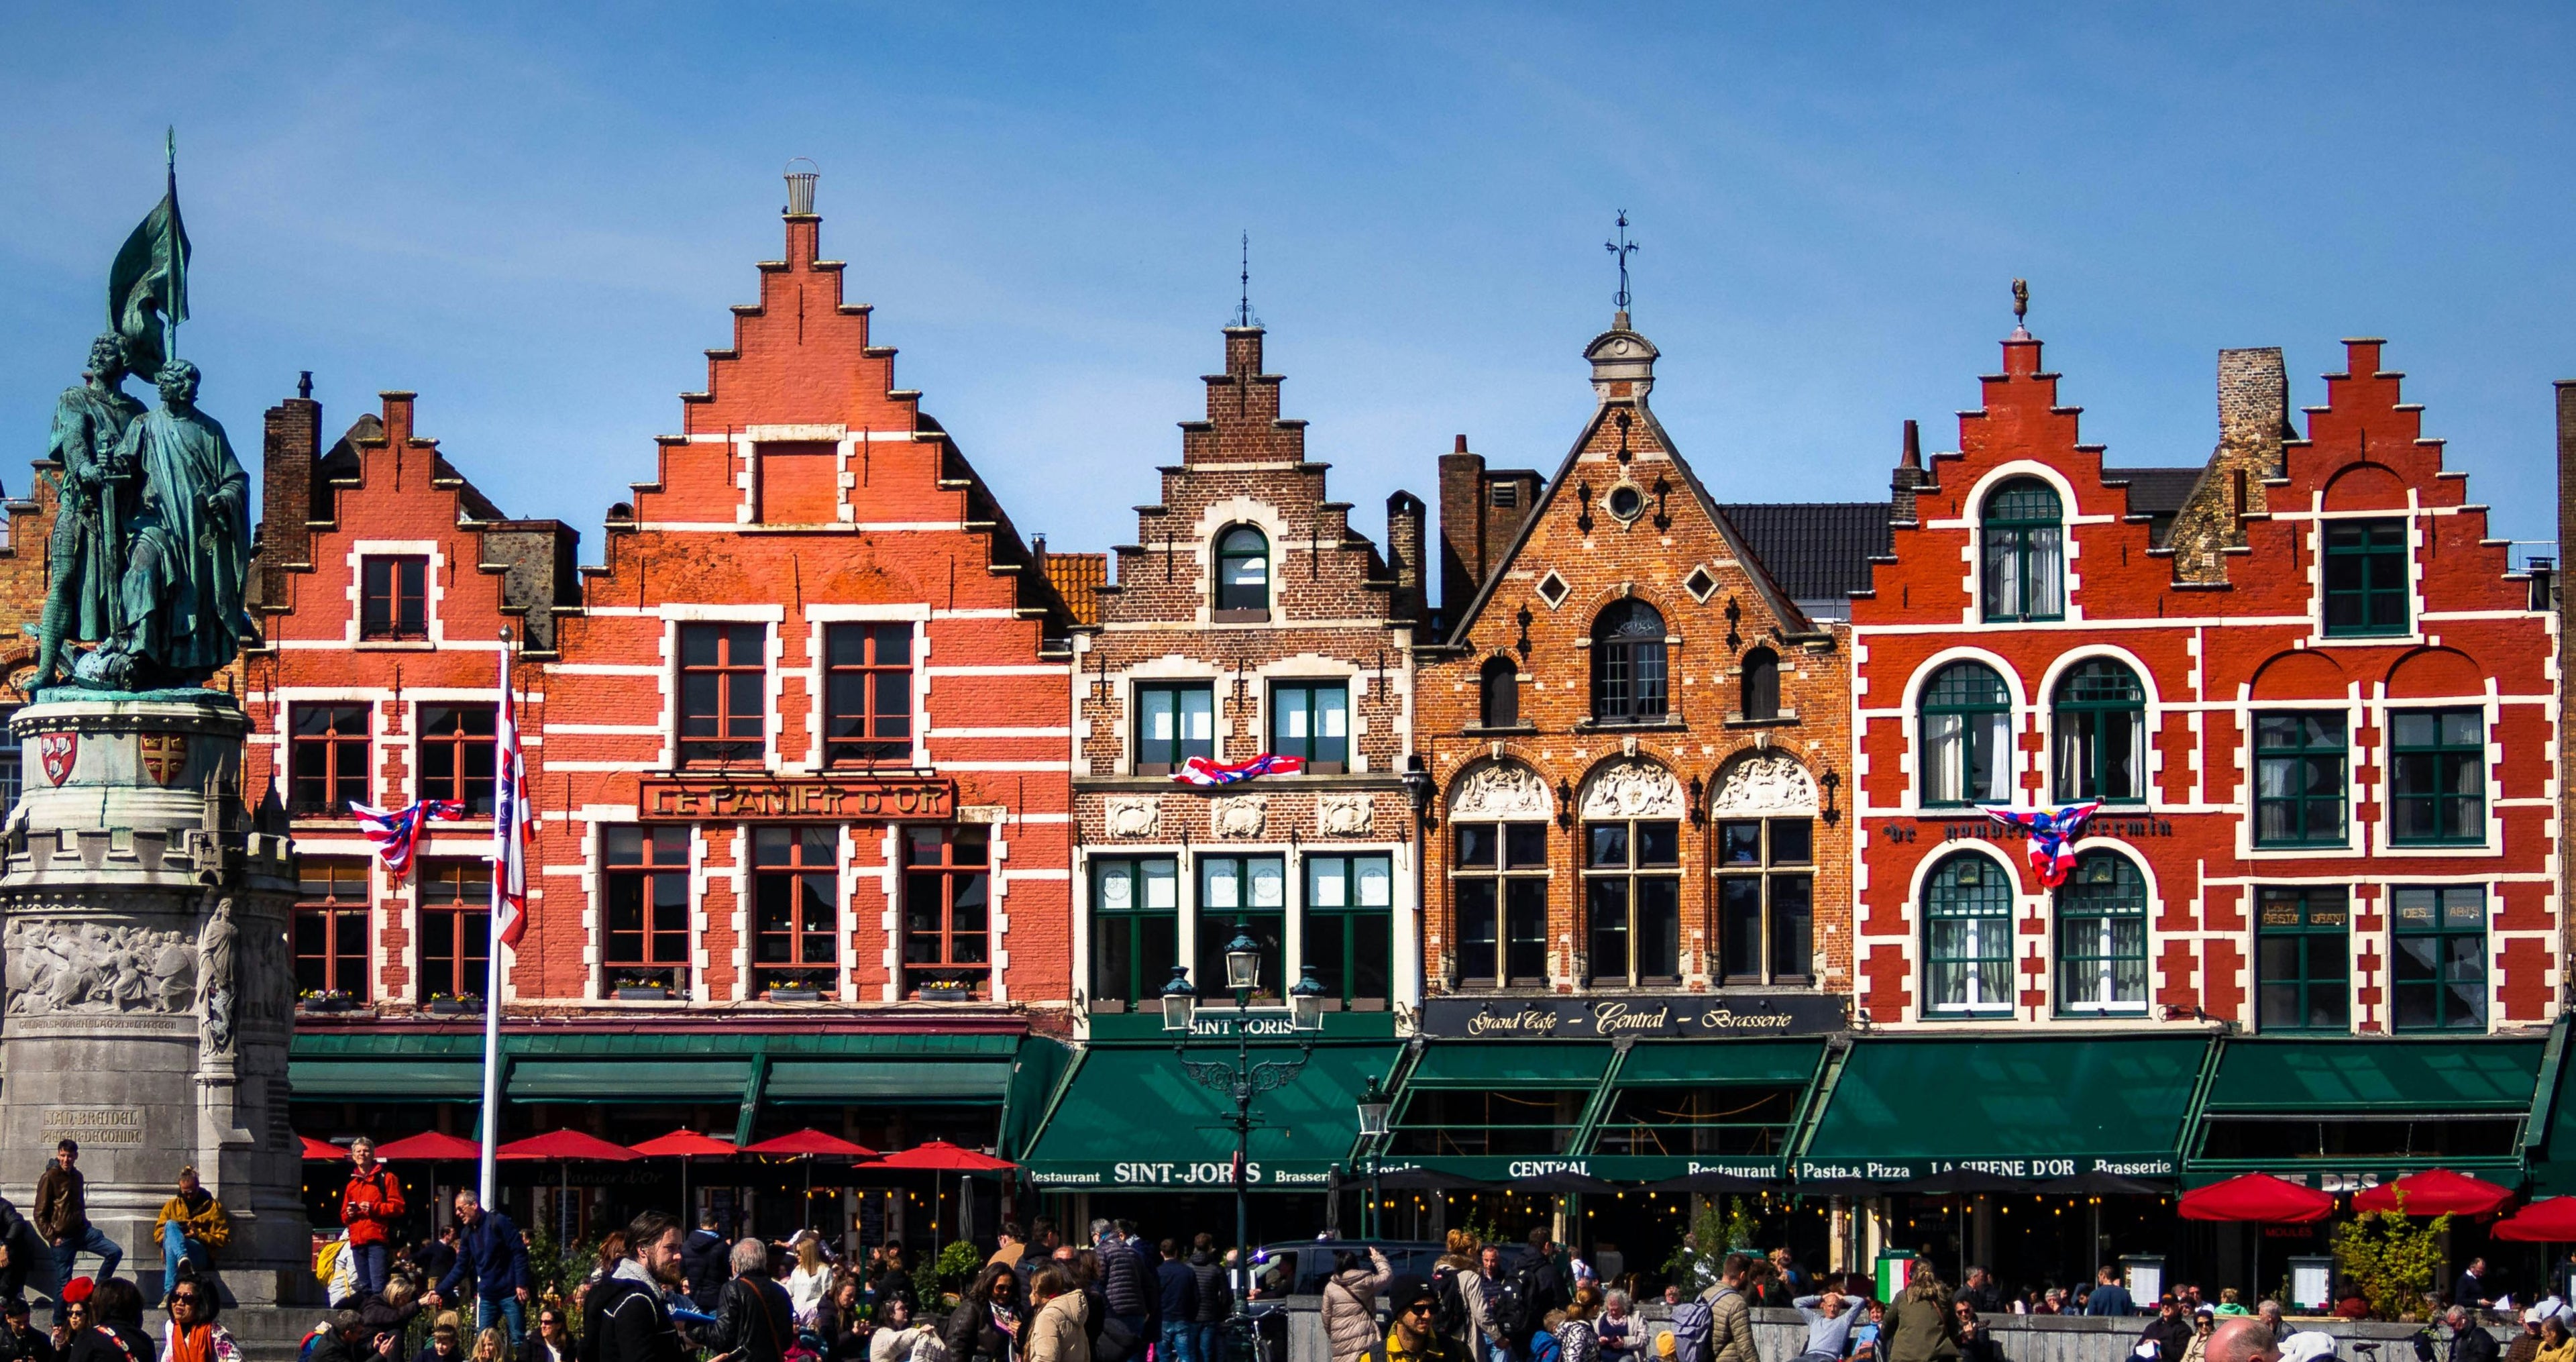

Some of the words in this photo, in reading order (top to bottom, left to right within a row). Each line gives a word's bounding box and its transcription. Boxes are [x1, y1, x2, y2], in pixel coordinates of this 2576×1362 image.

[653, 791, 697, 814] LE
[710, 785, 844, 815] PANIER
[859, 785, 942, 814] D'OR
[2085, 819, 2171, 837] eermin
[1468, 1011, 1521, 1035] Grand
[1595, 1002, 1668, 1035] Central
[1702, 1009, 1792, 1028] Brasserie
[1114, 1162, 1261, 1183] SINT-JORS
[1275, 1170, 1332, 1183] Brasseri
[1509, 1161, 1591, 1177] CENTRAL
[1803, 1163, 1846, 1178] Pasta
[1851, 1166, 1862, 1178] &
[1867, 1162, 1910, 1177] Pizza
[2033, 1159, 2075, 1175] D'OR
[2092, 1159, 2172, 1175] Brasserie
[2321, 1173, 2379, 1192] DES
